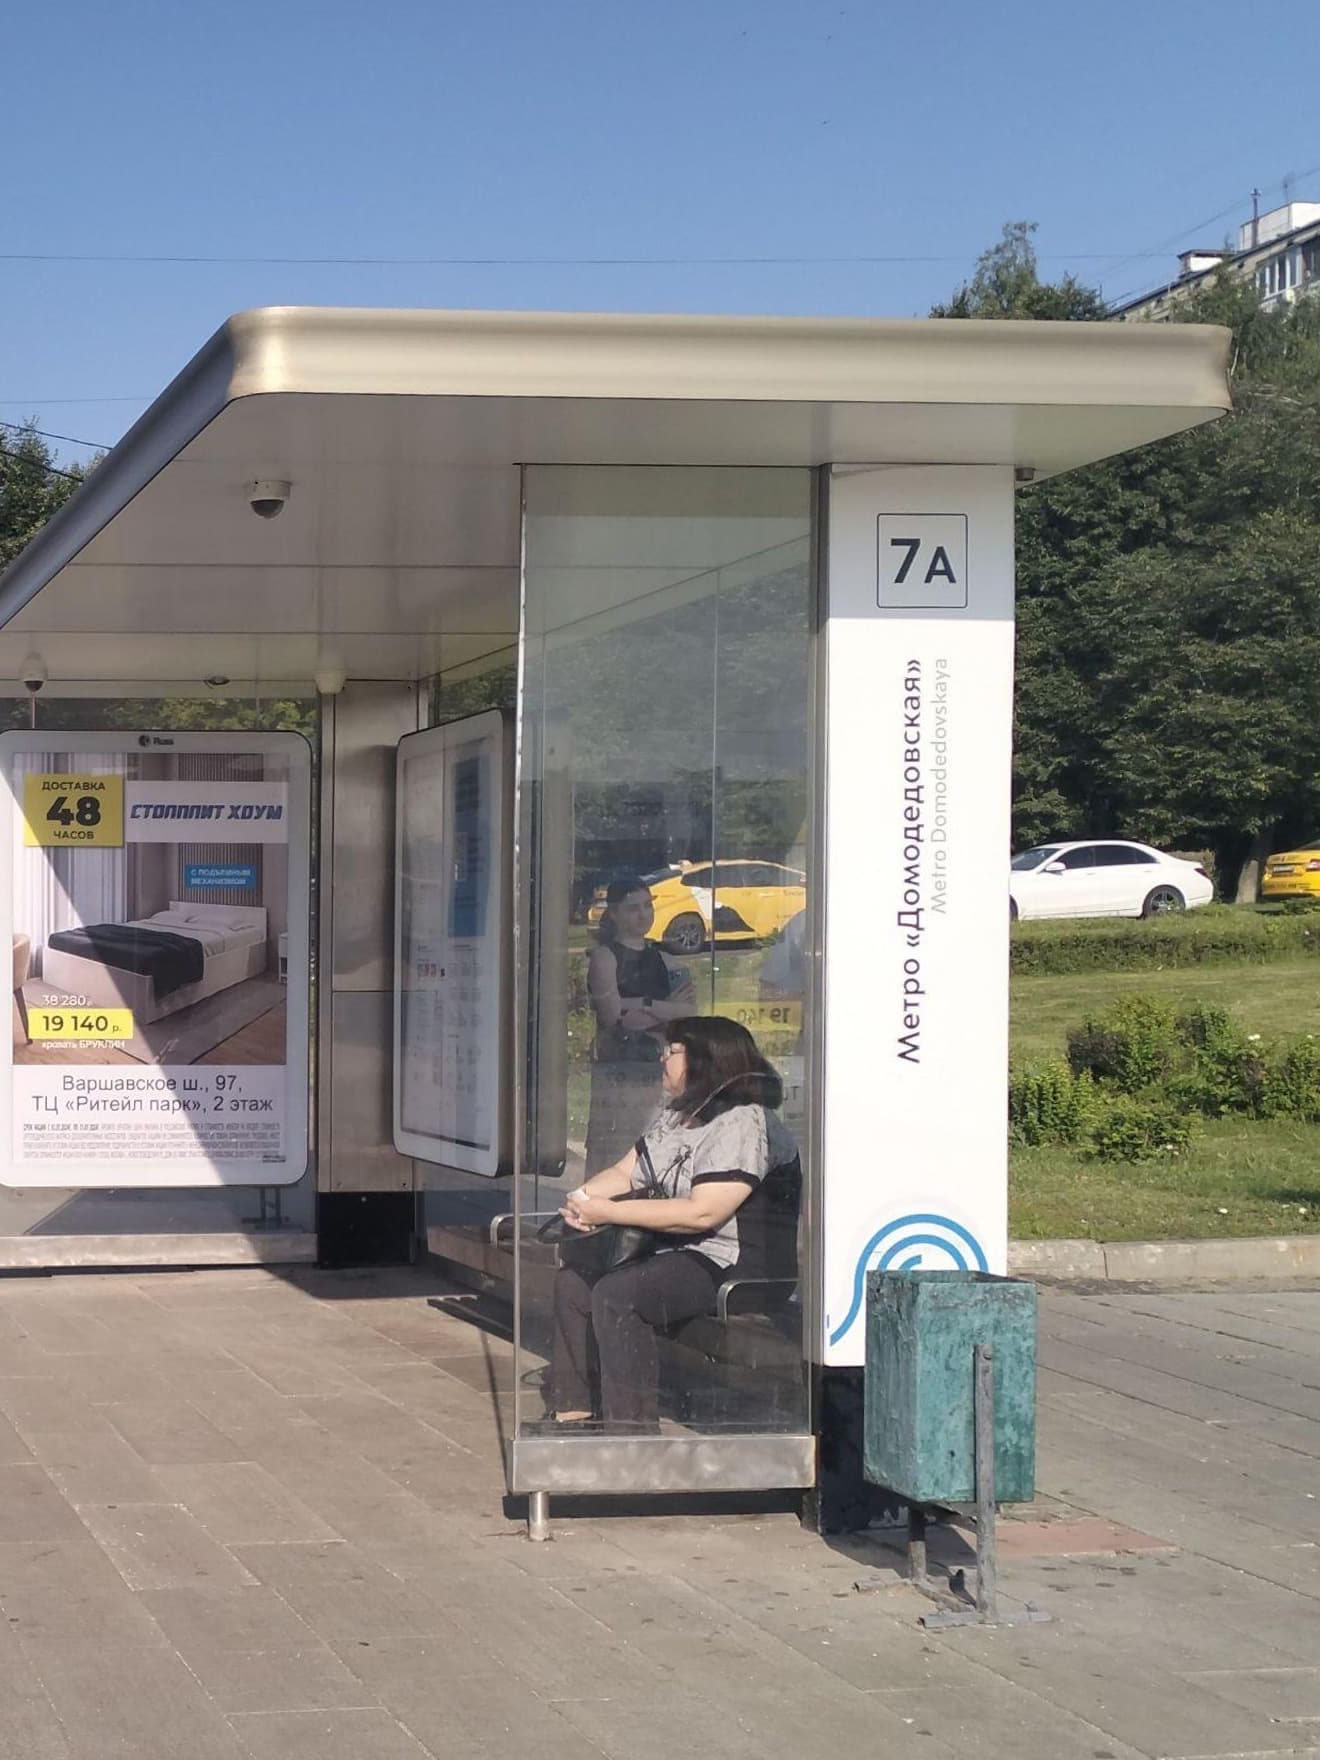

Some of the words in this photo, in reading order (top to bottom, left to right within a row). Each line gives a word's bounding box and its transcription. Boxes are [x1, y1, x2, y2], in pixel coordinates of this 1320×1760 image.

[890, 537, 957, 584] 7А
[930, 657, 950, 843] Domodedovskaya
[41, 781, 106, 792] ДОСТАВКА
[46, 796, 101, 827] 48
[227, 804, 283, 820] ХОУМ
[896, 658, 926, 949] «Домодедовская»
[53, 830, 95, 841] ЧАСОВ
[930, 849, 947, 915] Metro
[896, 957, 926, 1064] Метро
[42, 1015, 64, 1032] 19
[71, 1015, 109, 1032] 140
[79, 1040, 126, 1049] БРУКЛИН
[62, 1074, 177, 1094] Варшавское
[215, 1074, 243, 1094] 97,
[31, 1095, 59, 1115] ТЦ
[65, 1095, 143, 1112] «Ритейл
[149, 1098, 207, 1114] парк»,
[213, 1095, 225, 1112] 2
[229, 1098, 274, 1112] этаж
